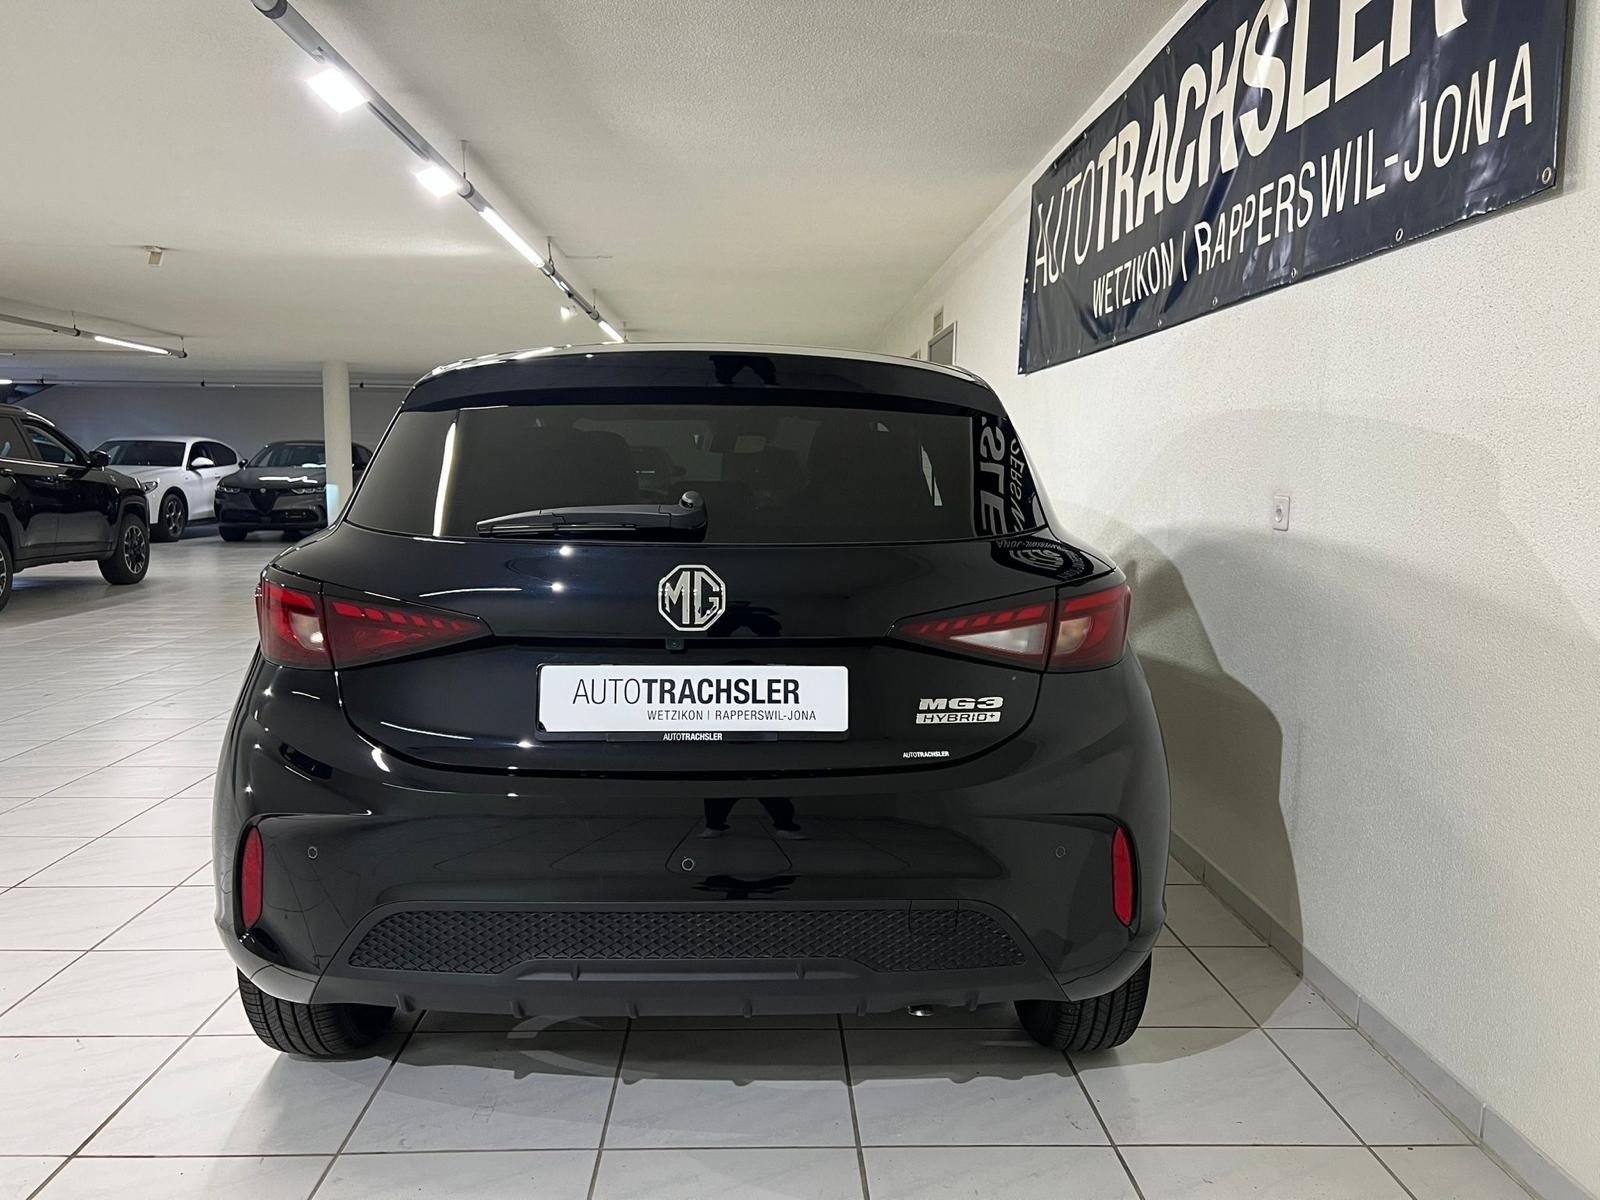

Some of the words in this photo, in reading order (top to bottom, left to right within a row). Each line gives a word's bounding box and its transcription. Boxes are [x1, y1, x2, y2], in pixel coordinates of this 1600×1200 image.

[1092, 237, 1174, 319] WETZIKON
[1194, 42, 1533, 275] RAPPERSWIL-JONA
[664, 570, 720, 625] MG
[572, 678, 801, 705] AUTOTRACHSLER
[919, 696, 1004, 710] MG3
[647, 710, 703, 721] WETZIKON
[715, 710, 817, 721] RAPPERSWIL-JONA
[662, 732, 723, 742] AUTOTRACHSLER
